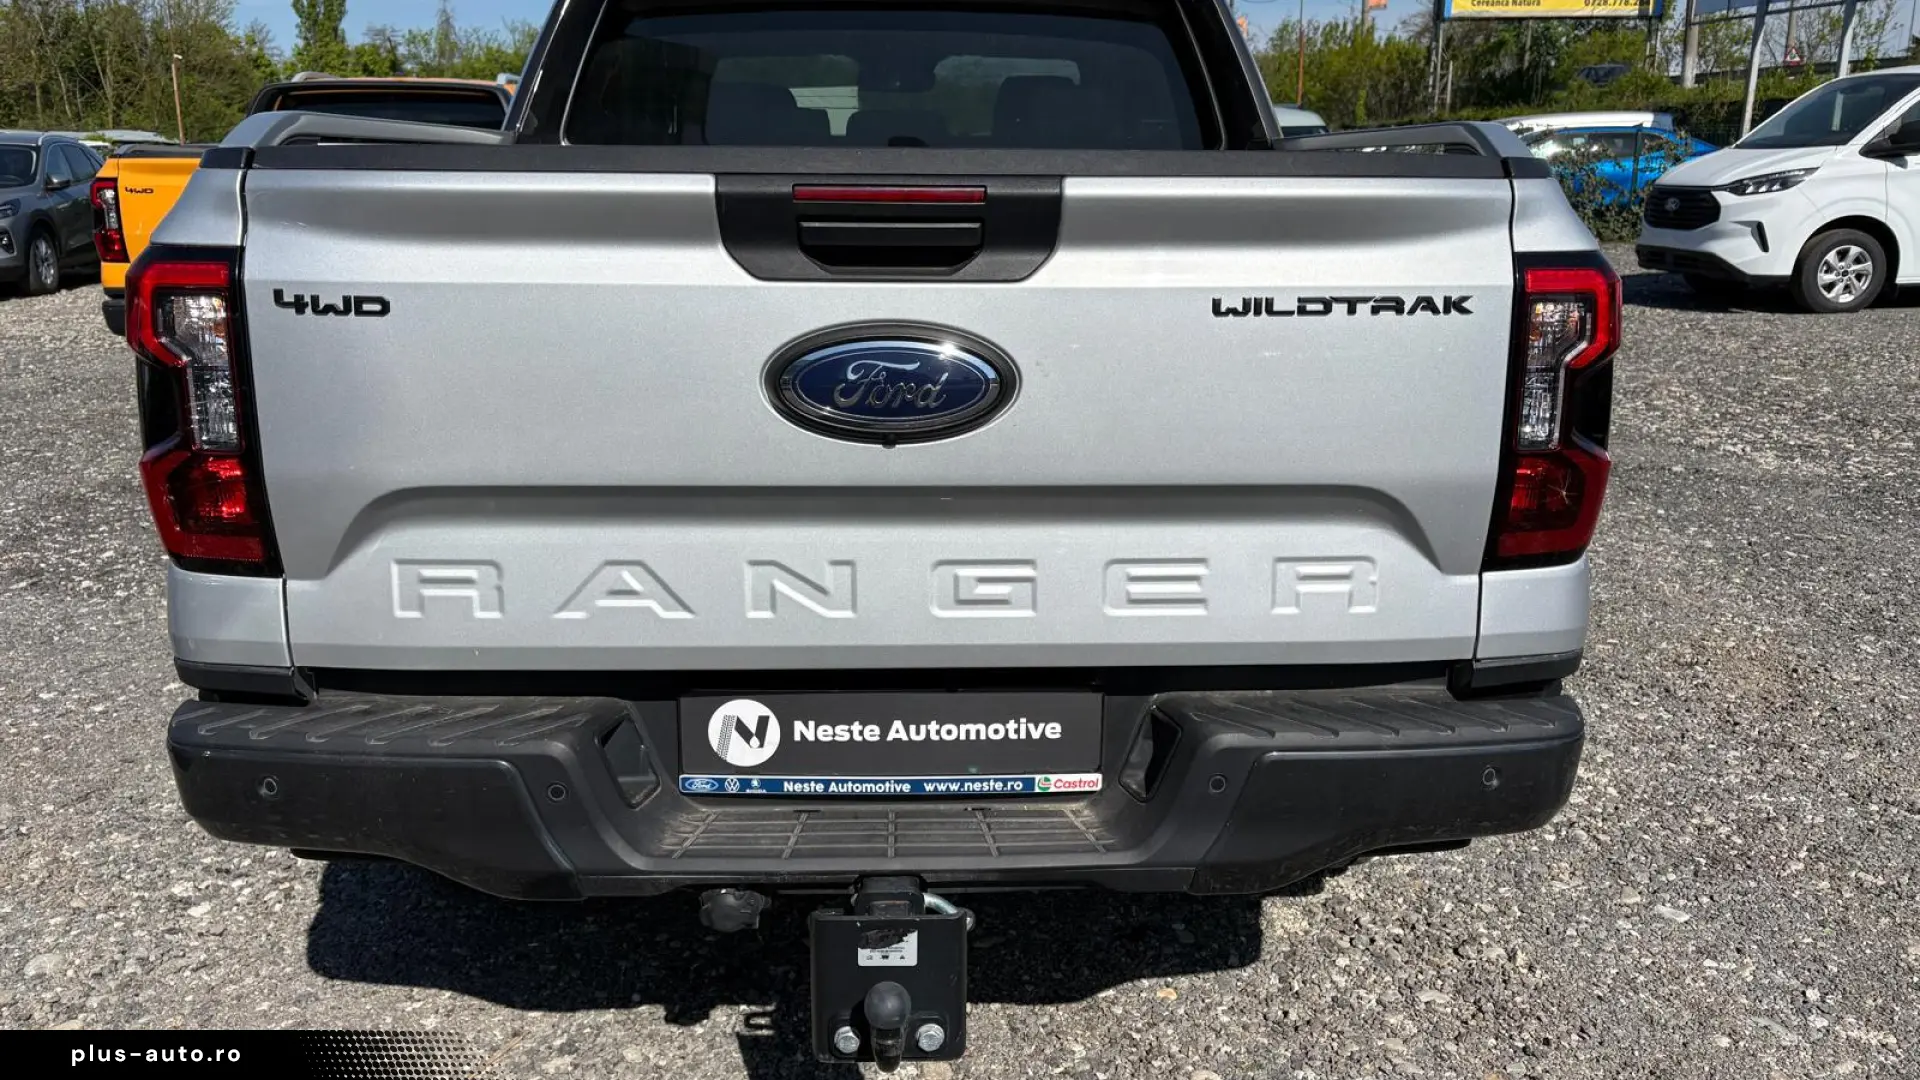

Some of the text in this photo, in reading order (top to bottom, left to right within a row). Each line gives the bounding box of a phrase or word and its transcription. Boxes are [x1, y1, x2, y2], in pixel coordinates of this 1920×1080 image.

[125, 186, 154, 194] 4WD
[273, 288, 390, 318] 4WD
[1211, 295, 1475, 318] WILDTRAK
[833, 359, 949, 409] Ford
[389, 554, 1379, 620] RANGER
[793, 717, 1063, 742] Neste Automotive
[783, 779, 1023, 793] Neste Automotive www.neste.ro
[1053, 778, 1100, 790] Castrol
